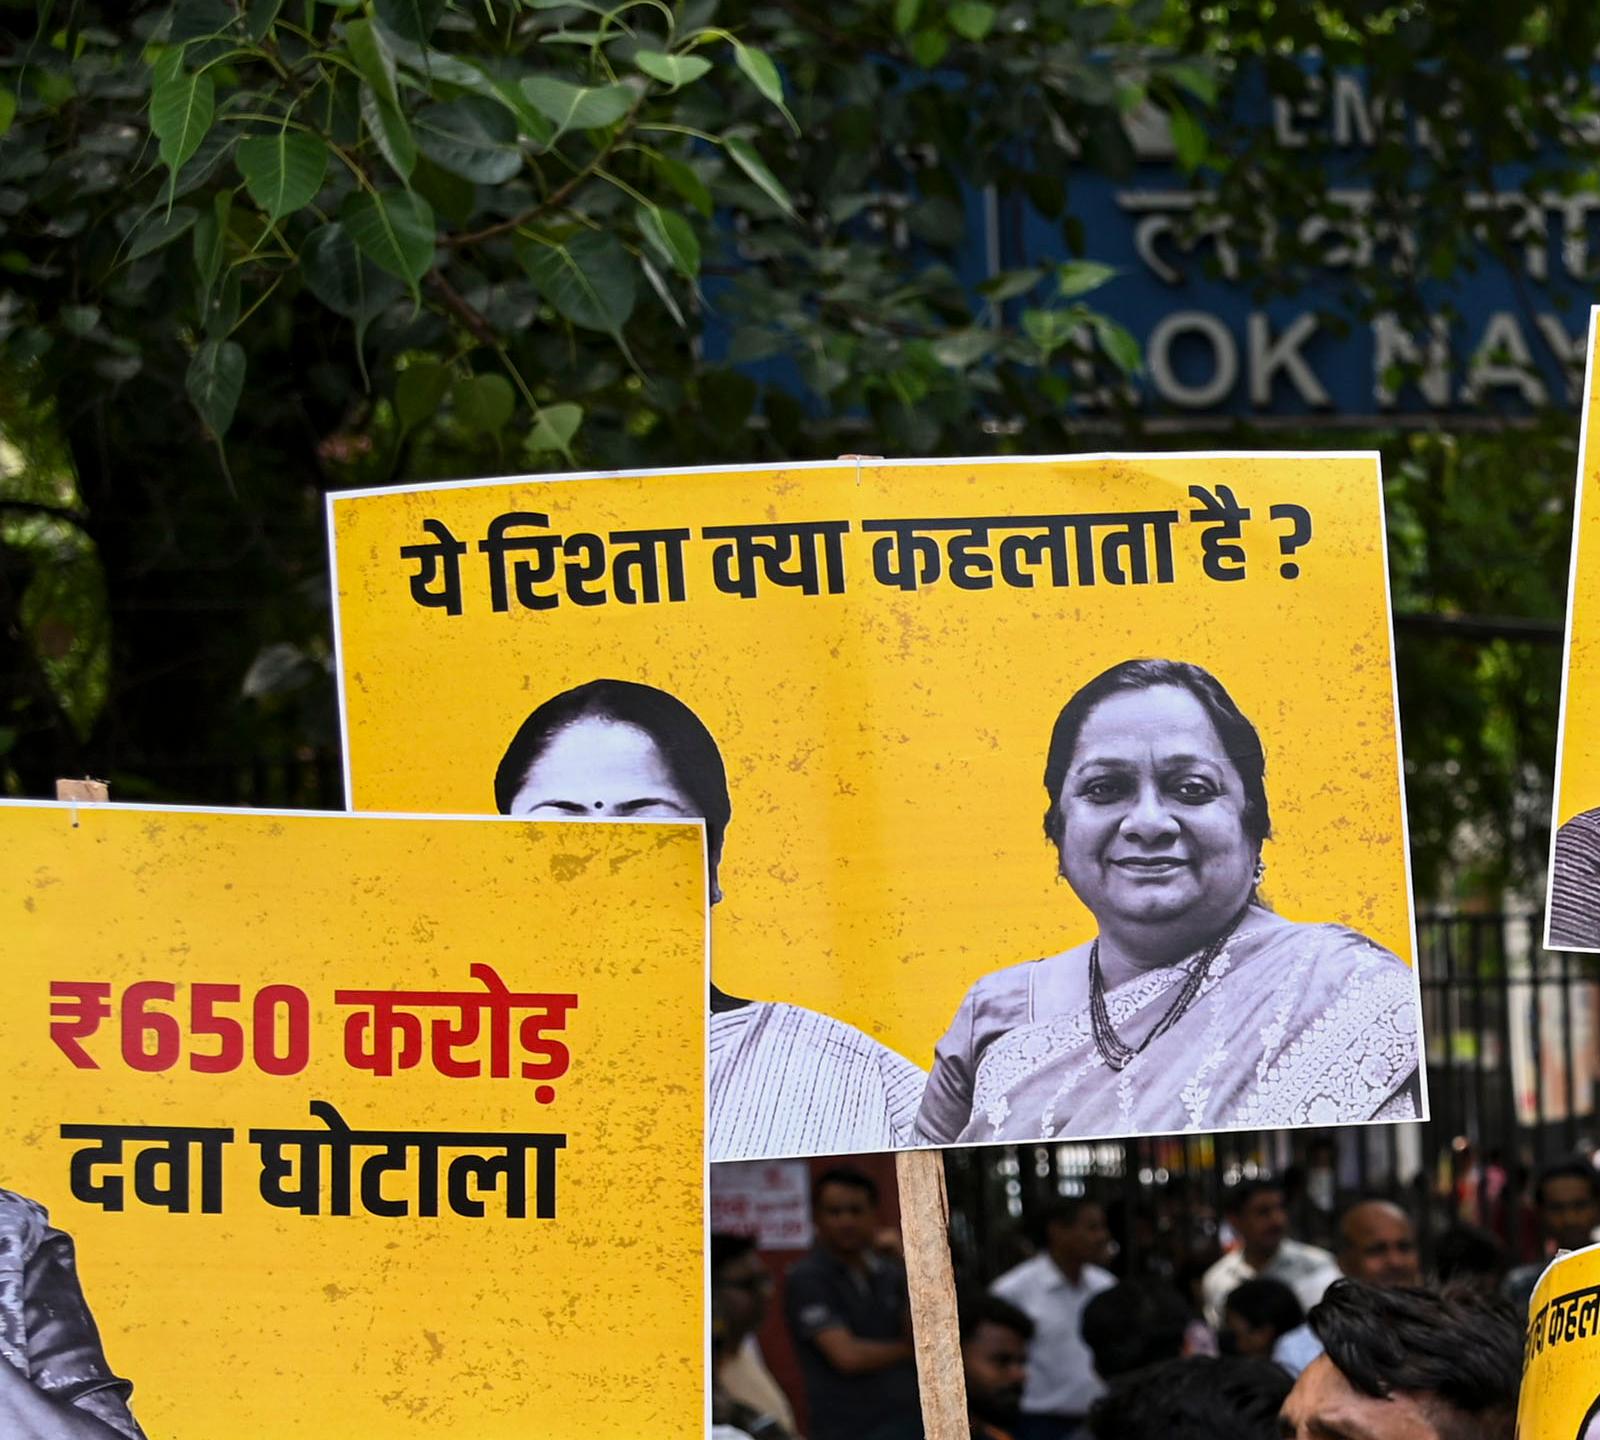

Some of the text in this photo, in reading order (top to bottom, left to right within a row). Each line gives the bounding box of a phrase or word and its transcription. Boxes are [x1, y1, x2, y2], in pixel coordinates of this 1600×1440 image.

[400, 484, 1313, 617] ये रिश्ता क्या कहलाता है ?
[49, 962, 579, 1105] ₹650 करोड़
[59, 1100, 567, 1220] दवा घोटाला
